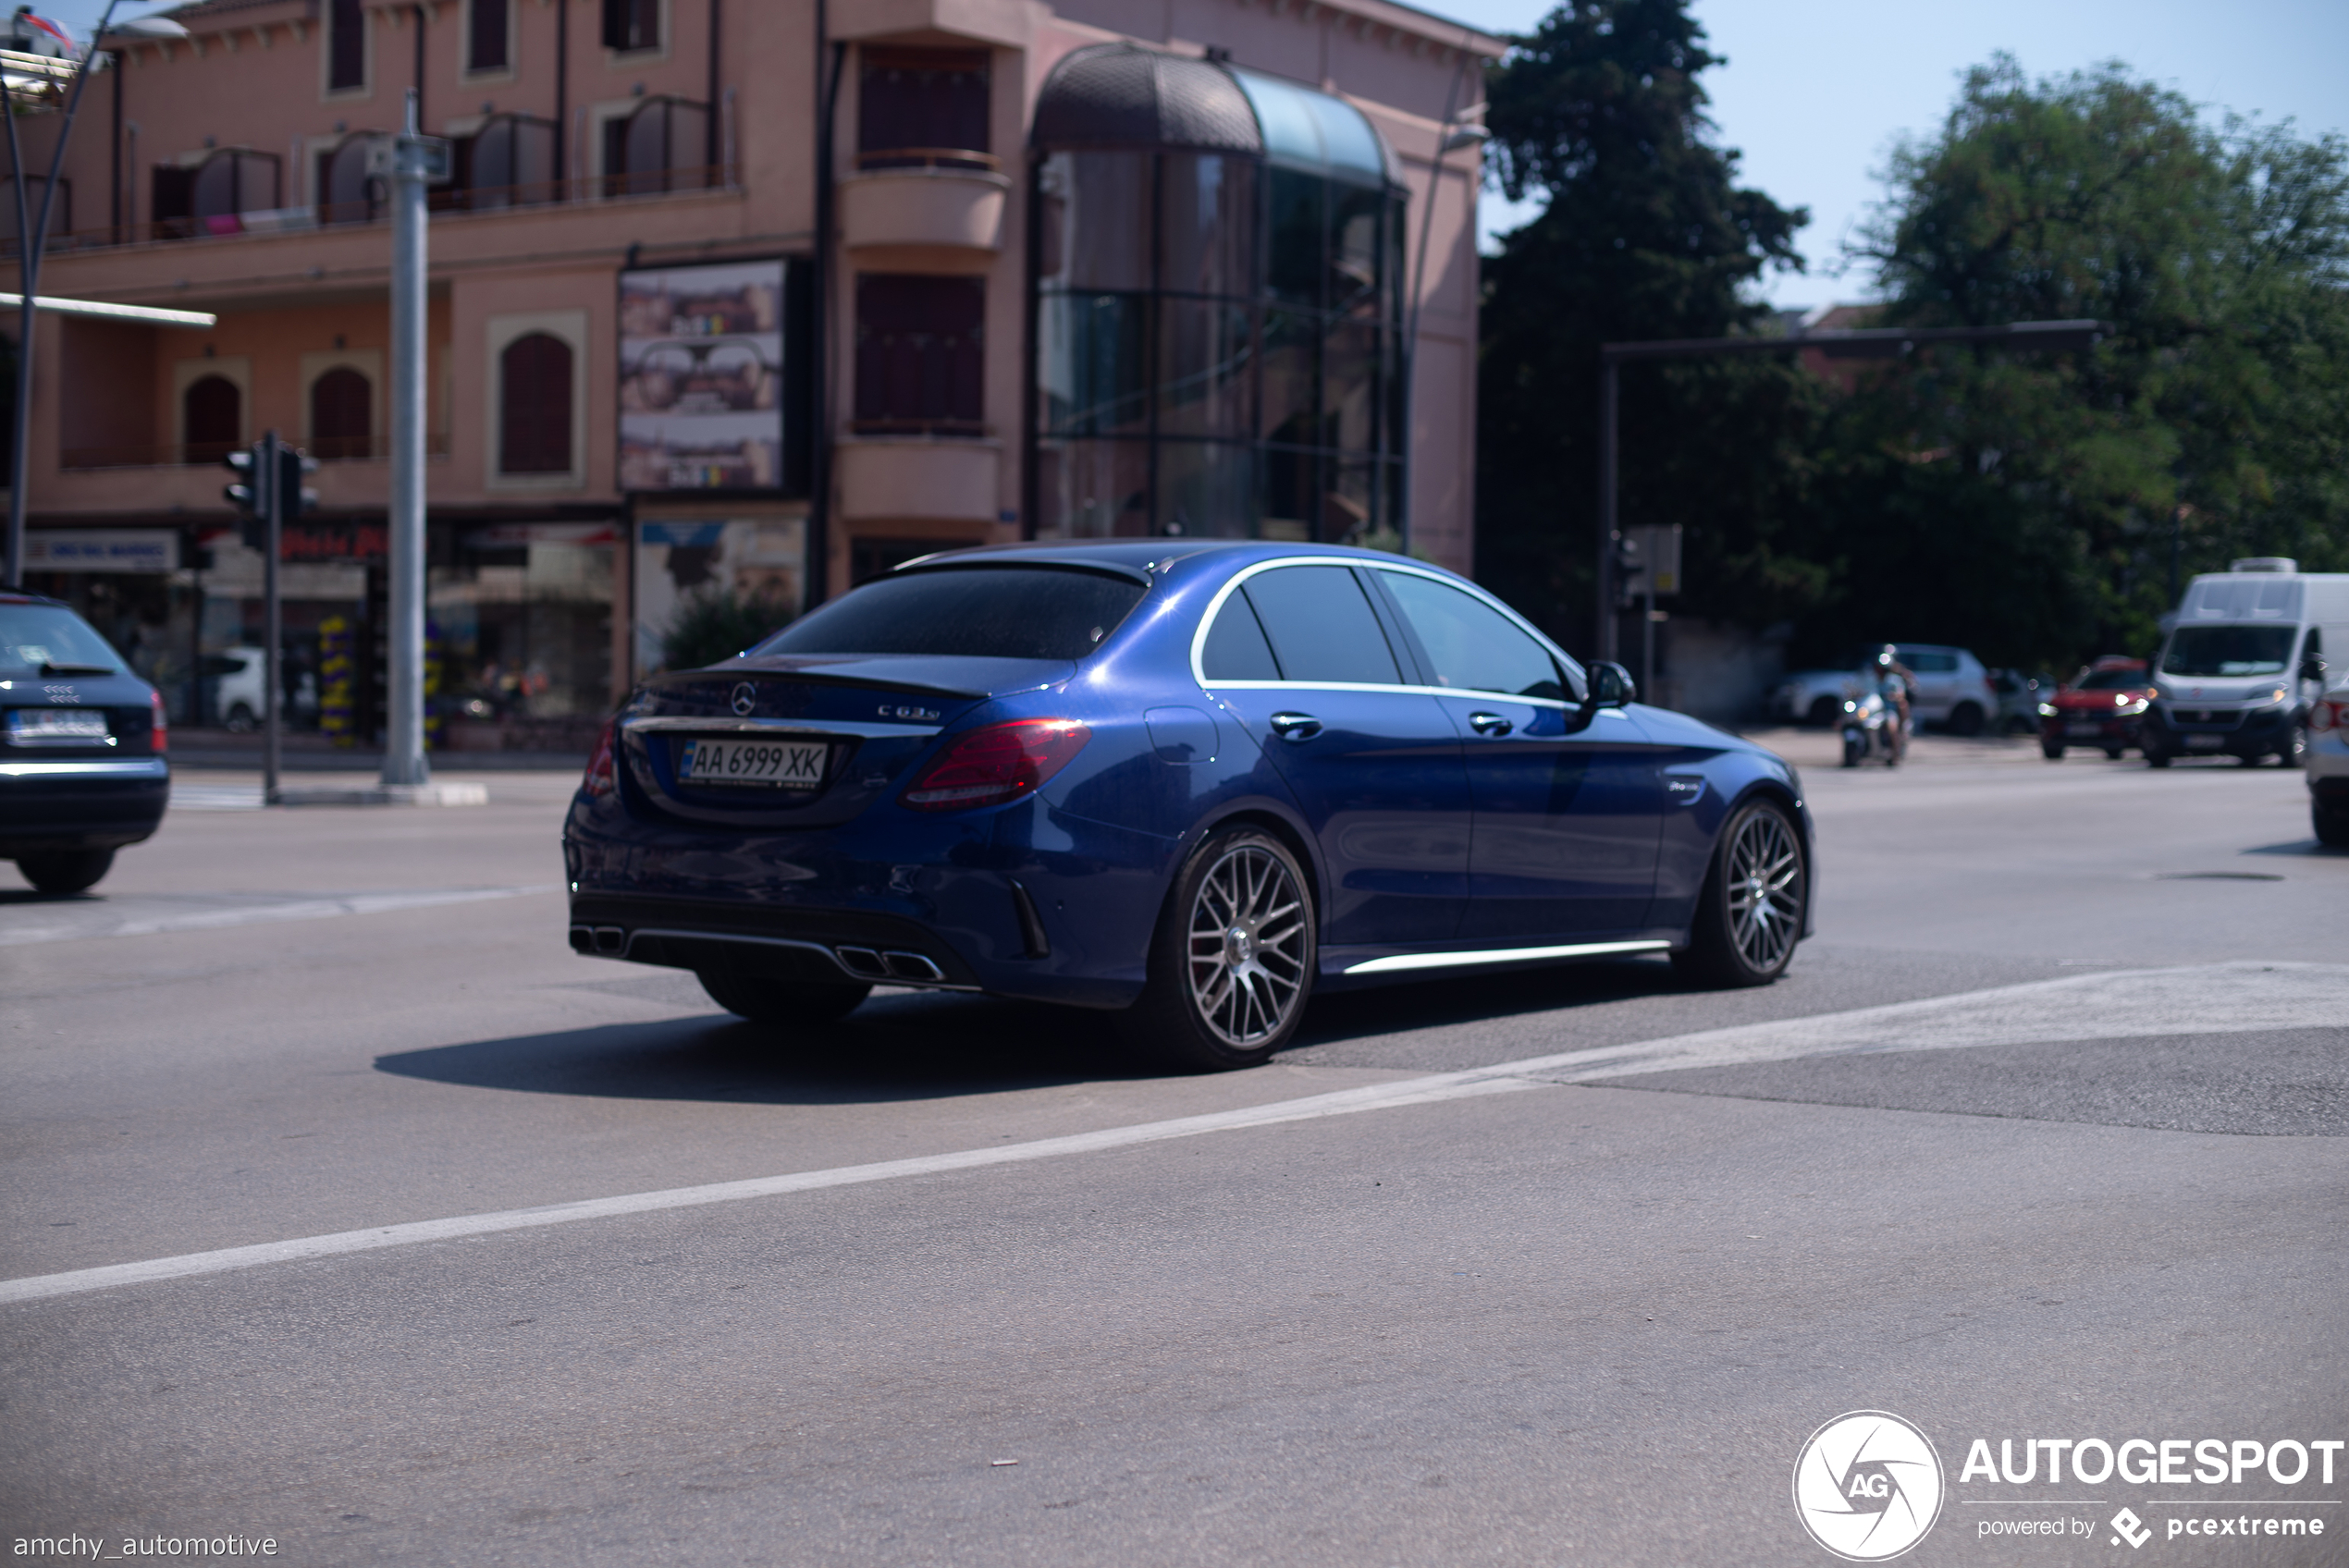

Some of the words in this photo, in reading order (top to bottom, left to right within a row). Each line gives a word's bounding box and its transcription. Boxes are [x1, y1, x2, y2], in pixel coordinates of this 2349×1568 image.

[693, 745, 722, 773] AA
[729, 746, 782, 775] 6999
[785, 748, 823, 778] XK
